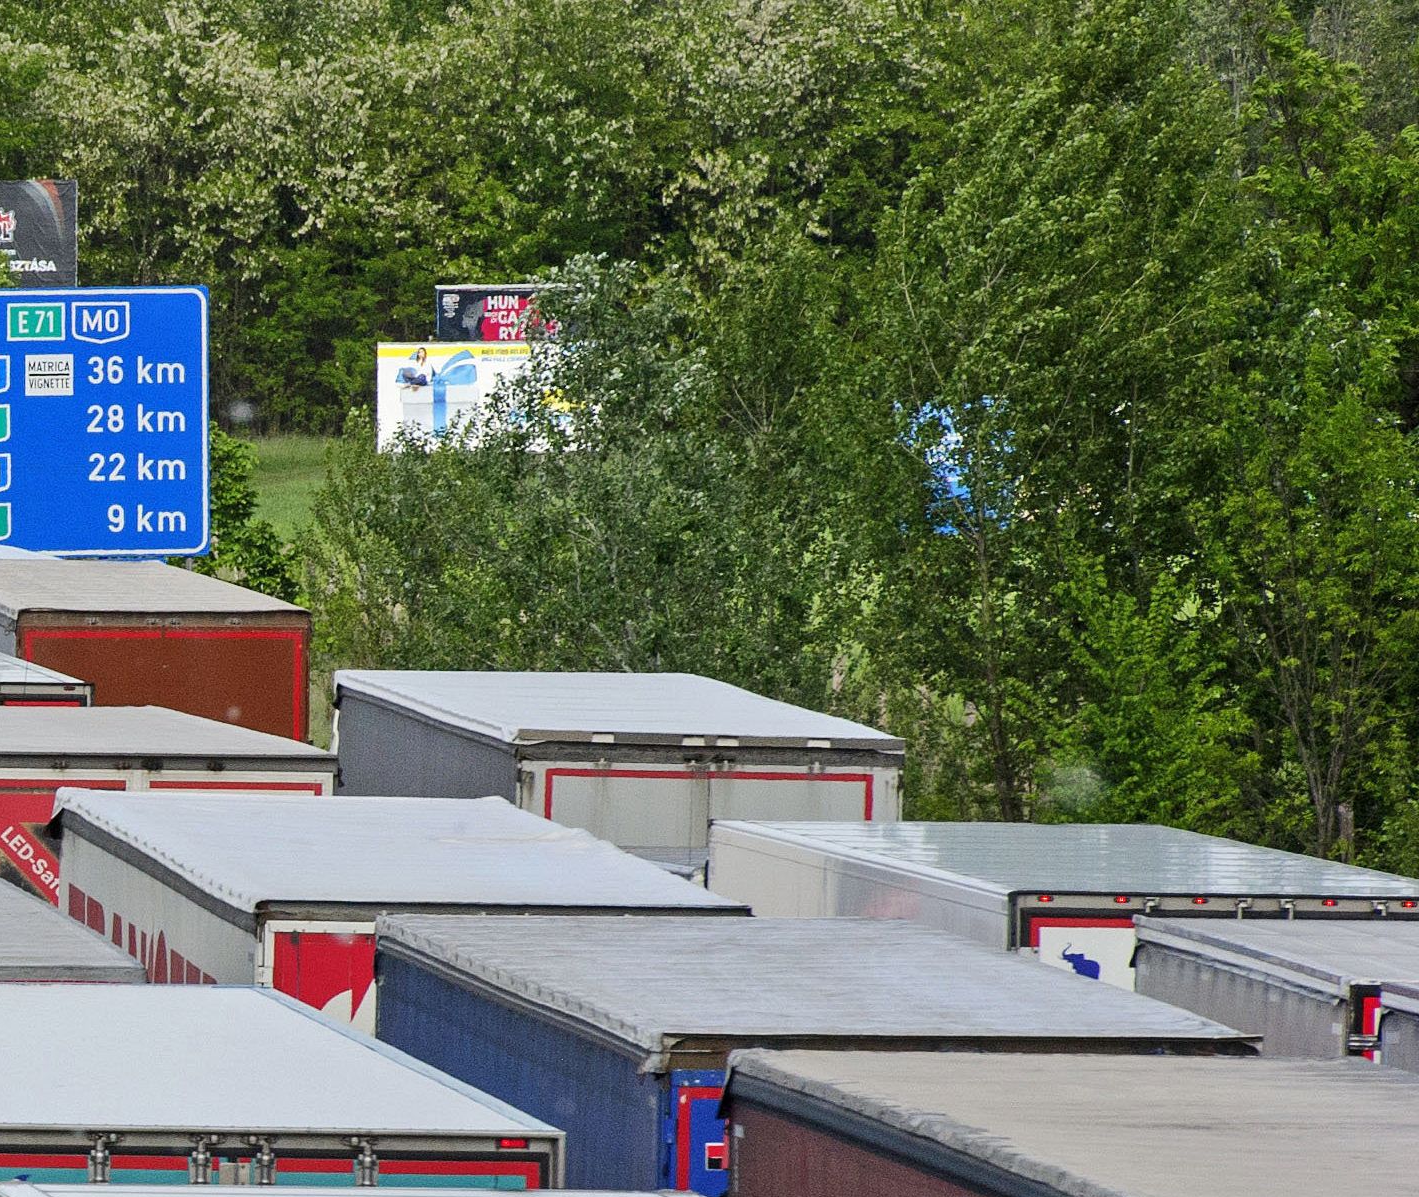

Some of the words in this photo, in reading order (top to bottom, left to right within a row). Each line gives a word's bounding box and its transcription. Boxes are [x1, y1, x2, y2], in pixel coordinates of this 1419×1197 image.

[487, 294, 520, 310] HUN
[81, 309, 119, 333] M0
[28, 361, 71, 372] MATRICA
[87, 355, 124, 384] 36
[136, 355, 186, 384] km
[28, 378, 71, 389] VIGNETTE
[86, 404, 125, 433] 28
[136, 403, 186, 433] km
[88, 452, 126, 482] 22
[137, 452, 187, 481] km
[107, 503, 125, 533] 9
[136, 504, 188, 532] km
